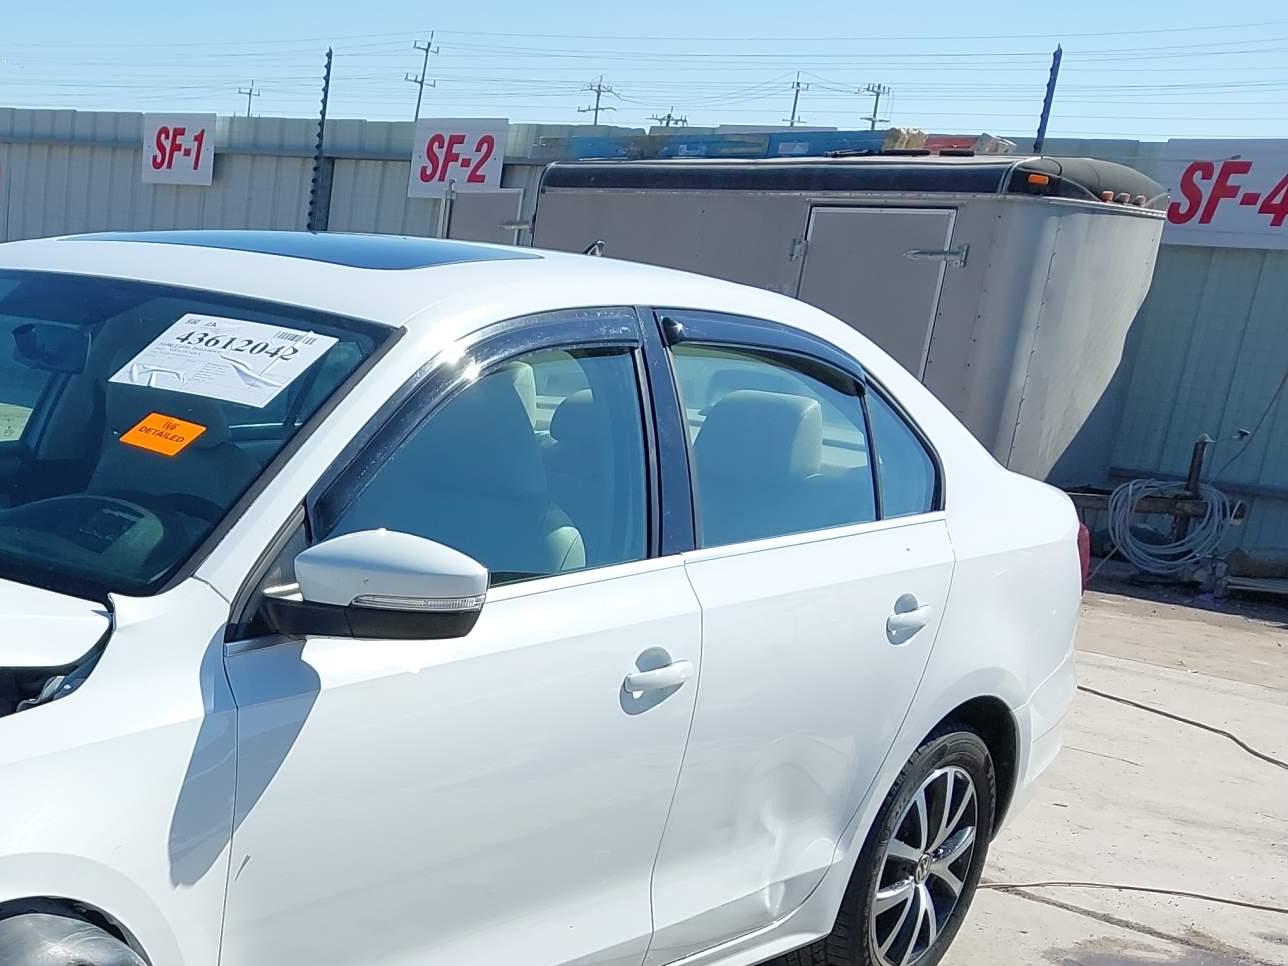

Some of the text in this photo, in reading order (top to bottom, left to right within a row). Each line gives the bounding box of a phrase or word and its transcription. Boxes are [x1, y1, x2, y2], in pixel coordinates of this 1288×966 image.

[152, 126, 205, 170] SF-1
[420, 133, 495, 183] SF-2
[175, 331, 299, 361] 43612042
[138, 425, 185, 443] DETAILED
